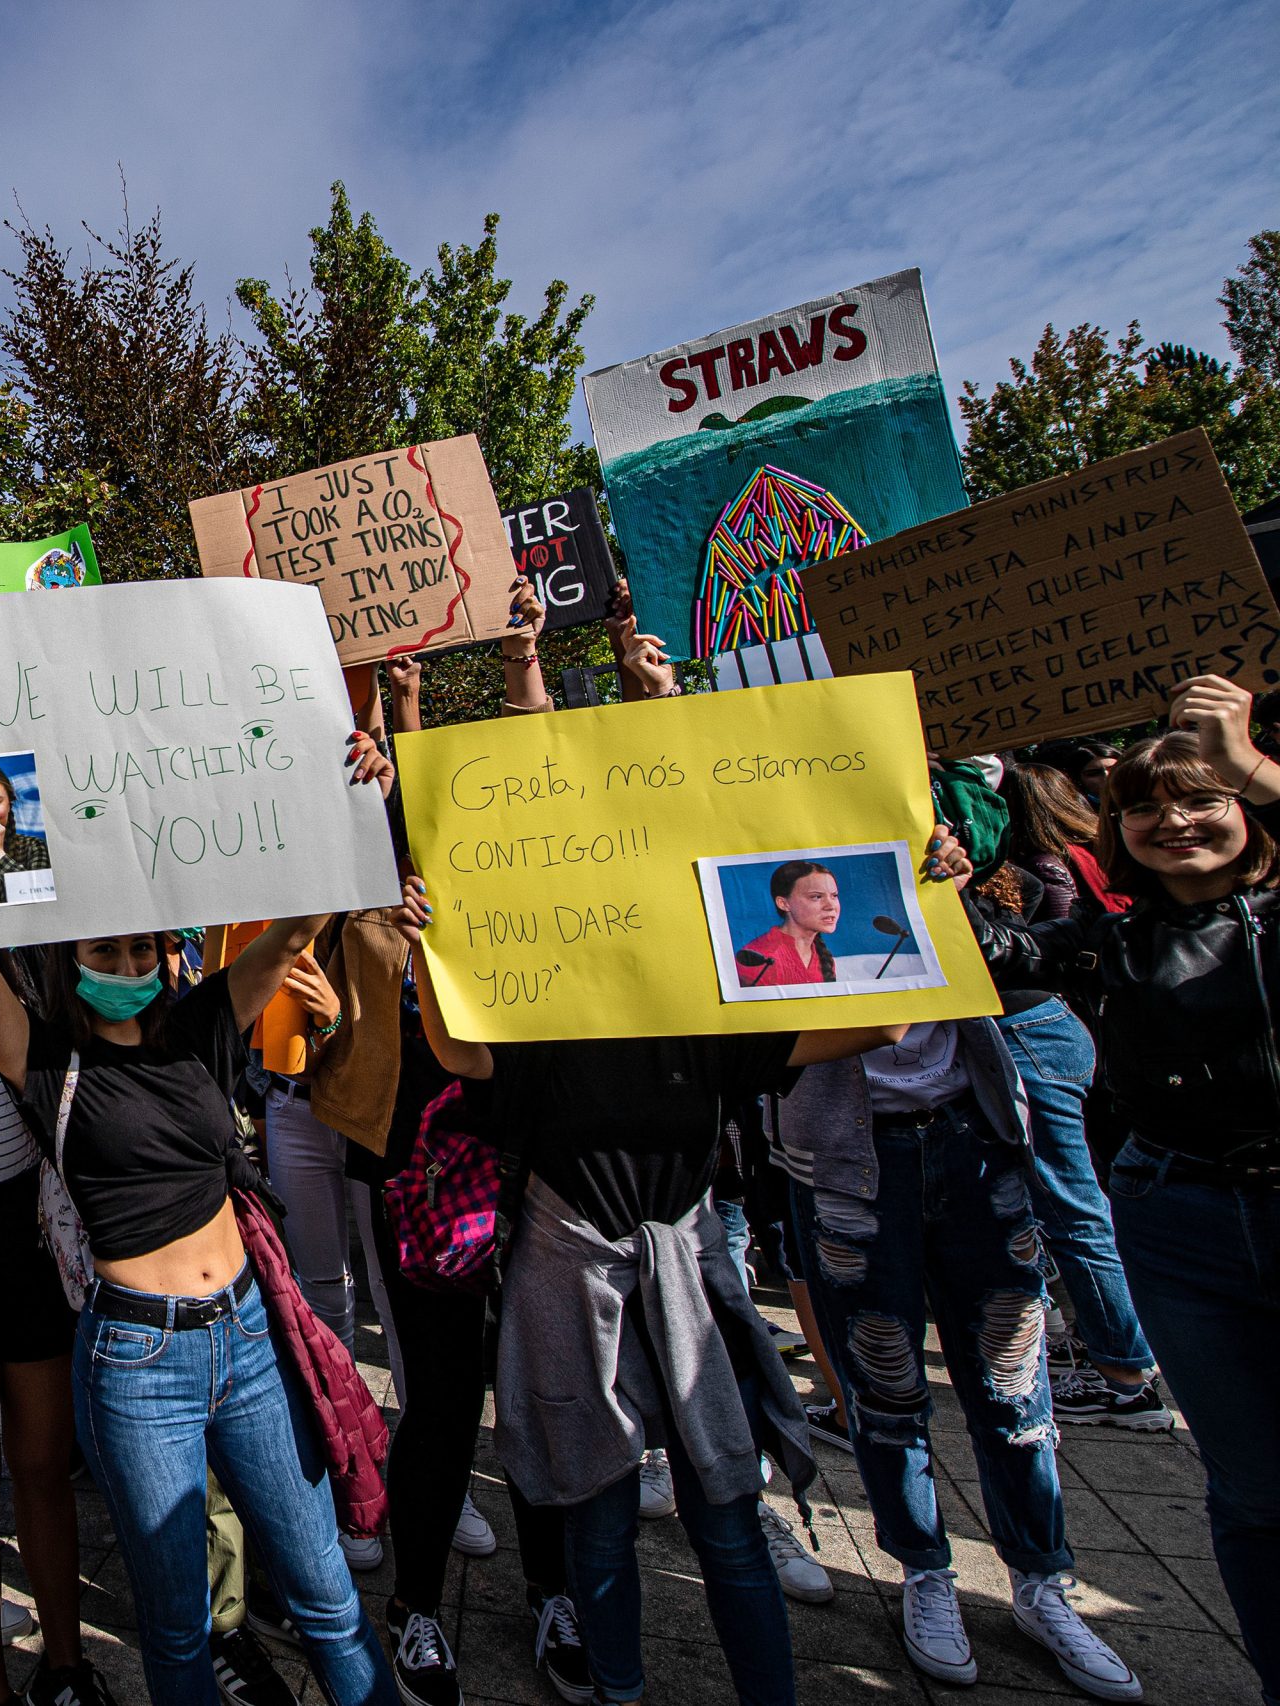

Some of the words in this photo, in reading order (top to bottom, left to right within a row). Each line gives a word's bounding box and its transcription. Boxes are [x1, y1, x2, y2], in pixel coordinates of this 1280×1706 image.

[660, 304, 867, 413] STRAWS
[264, 485, 294, 515] I
[315, 456, 398, 502] JUST
[262, 505, 341, 544] TOOK
[357, 499, 378, 526] A
[266, 537, 338, 578] TEST
[352, 517, 442, 556] TURNS
[826, 522, 979, 593] SENHORES
[1012, 445, 1205, 527] MINISTROS,
[341, 563, 394, 602] I'M
[401, 555, 449, 593] 100%
[840, 606, 859, 625] O
[884, 550, 1025, 611] PLANETA
[1064, 496, 1194, 559] AINDA
[327, 599, 419, 643] DYING
[848, 625, 900, 665] NÃO
[923, 588, 1005, 639] ESTÁ
[1027, 537, 1190, 608] QUENTE
[907, 607, 1100, 682] SUFICIENTE
[1139, 570, 1248, 618] PARA
[1045, 653, 1064, 678] O
[1077, 624, 1170, 669] GELO
[1191, 592, 1269, 636] DOS
[90, 667, 229, 716] WILL
[252, 663, 316, 704] BE
[65, 738, 295, 794] WATCHING
[712, 750, 867, 786] estamos
[131, 799, 286, 879] YOU!!
[448, 825, 650, 874] CONTIGO!!!
[555, 903, 643, 944] DARE
